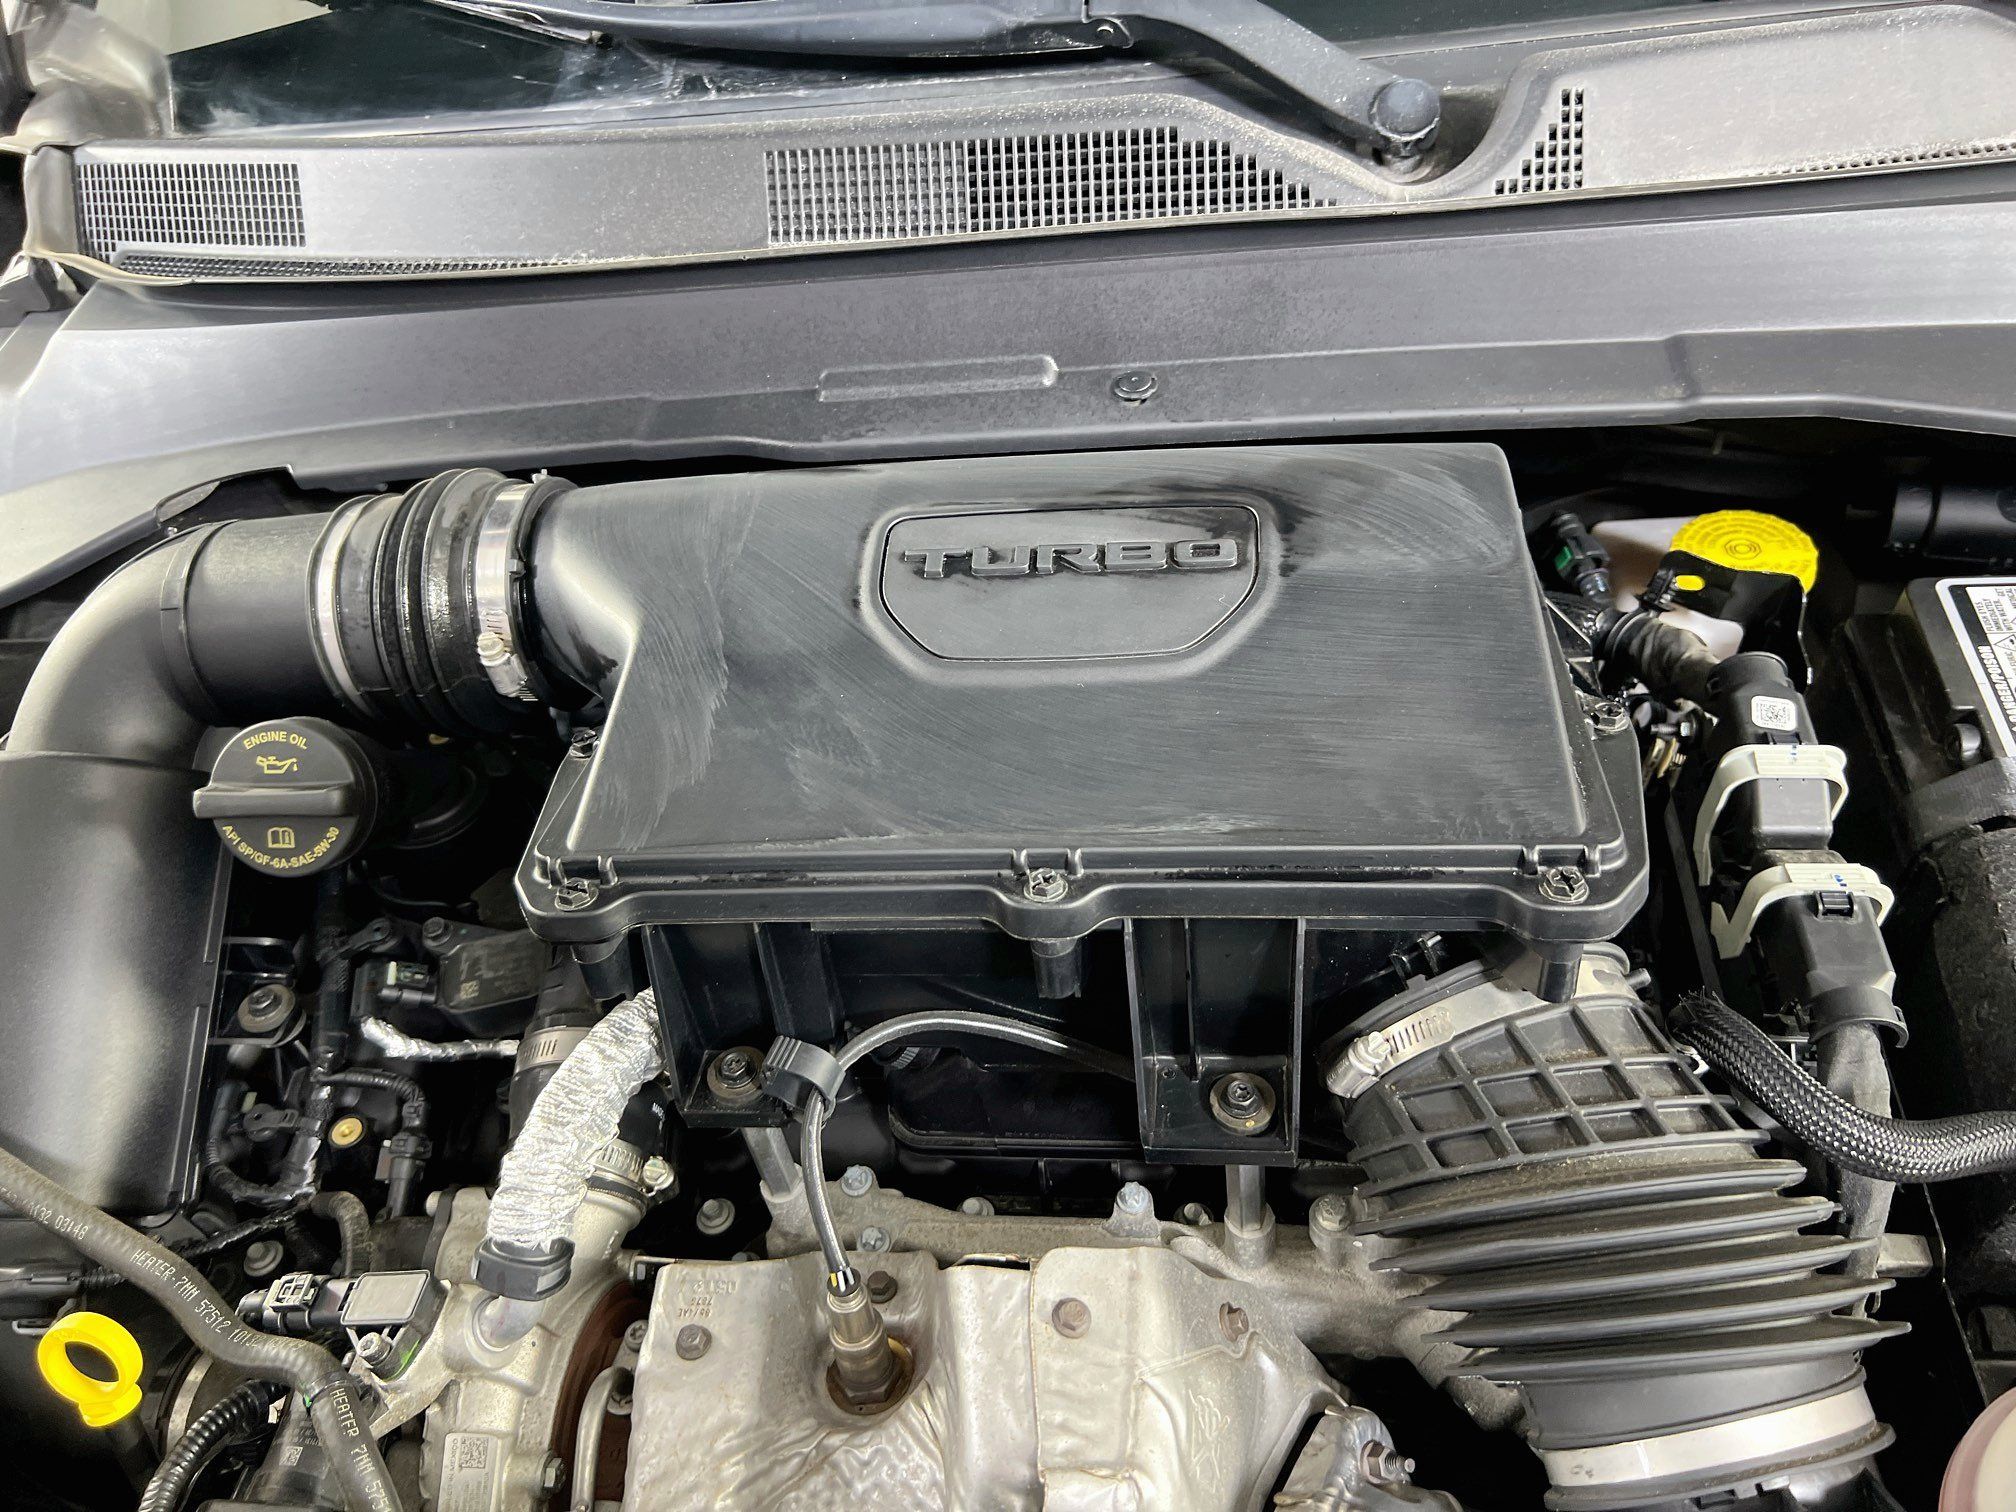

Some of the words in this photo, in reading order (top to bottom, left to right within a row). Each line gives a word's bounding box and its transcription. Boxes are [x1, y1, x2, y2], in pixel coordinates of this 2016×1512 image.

[904, 538, 1239, 579] TURBO
[1974, 601, 1987, 614] EYES
[1982, 598, 2004, 631] IMMEDIATELY
[1980, 614, 1995, 631] FLUSH
[243, 731, 287, 750] ENGINE
[289, 733, 309, 750] OIL
[222, 824, 240, 845] API
[194, 1298, 232, 1333] 57512
